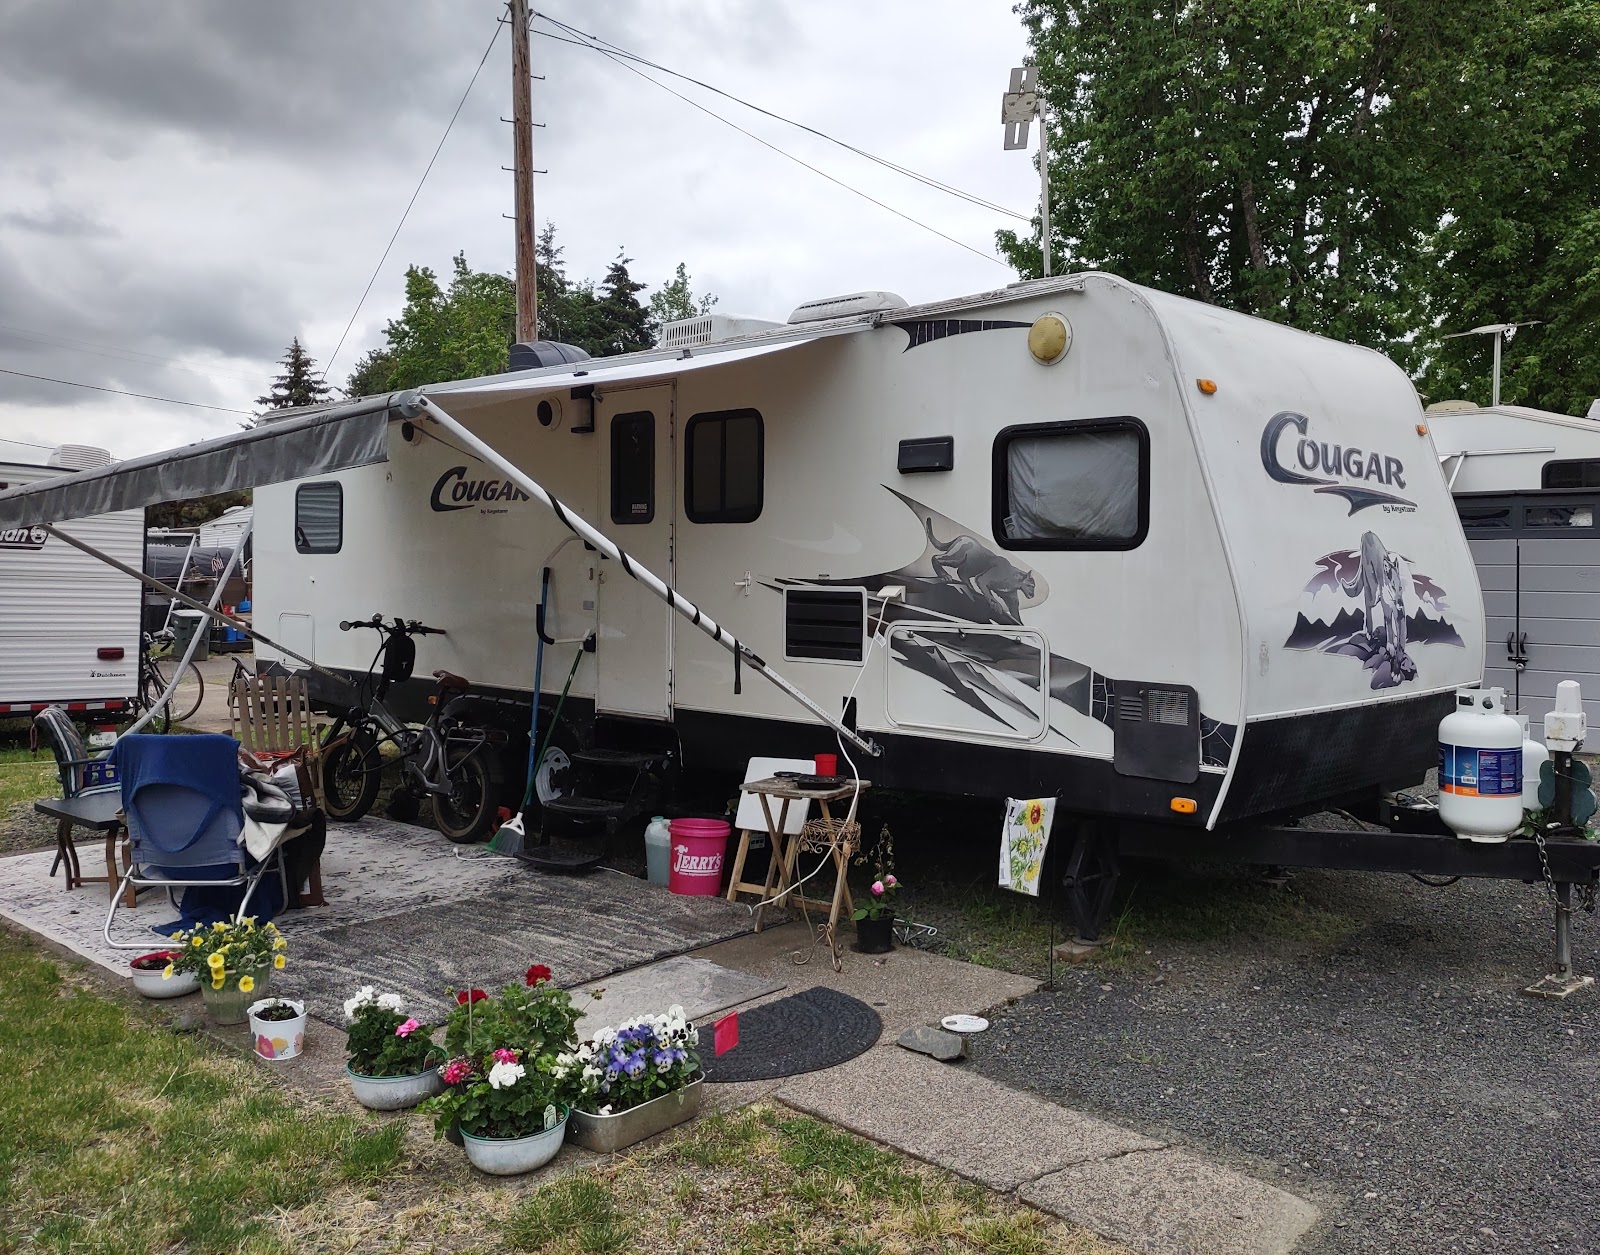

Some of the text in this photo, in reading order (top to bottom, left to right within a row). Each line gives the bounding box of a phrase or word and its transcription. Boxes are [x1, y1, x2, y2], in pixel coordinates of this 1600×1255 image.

[1260, 411, 1407, 490] COUGAR
[1382, 504, 1416, 514] by Keystone
[673, 851, 722, 873] JERRY'S
